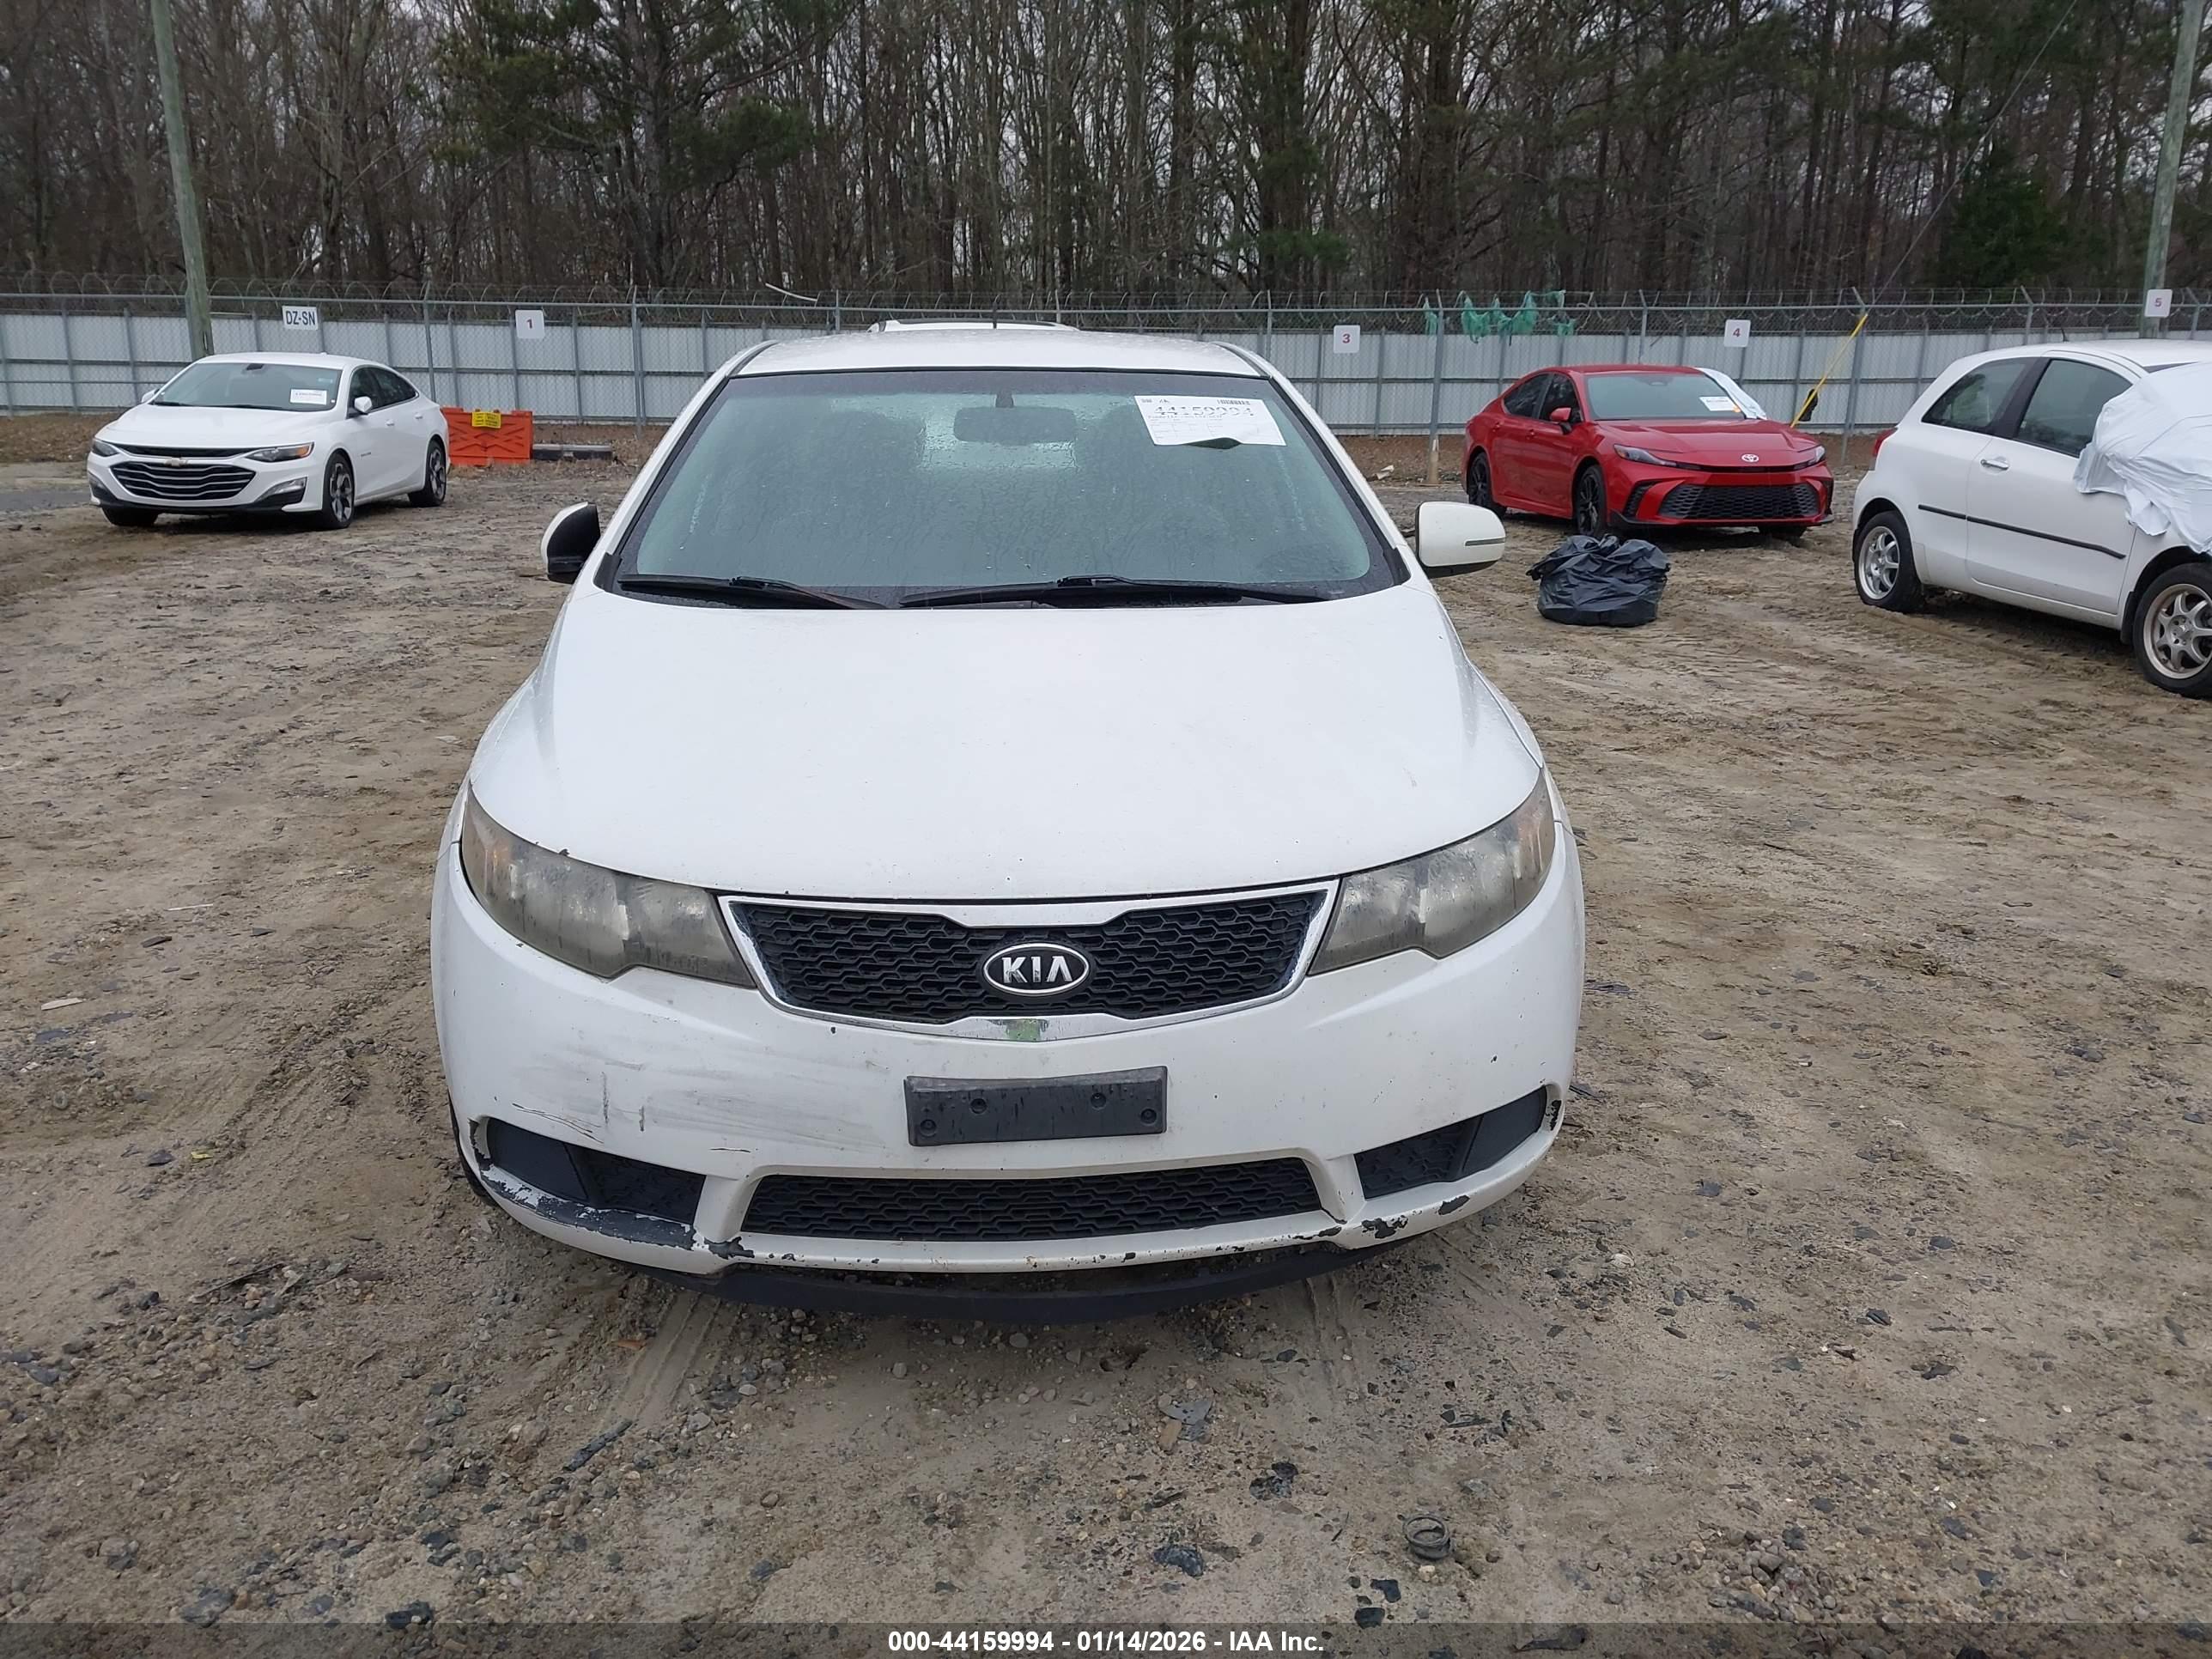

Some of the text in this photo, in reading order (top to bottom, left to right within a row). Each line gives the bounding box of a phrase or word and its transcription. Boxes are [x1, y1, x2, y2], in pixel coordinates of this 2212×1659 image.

[2154, 297, 2162, 307] 5
[285, 310, 316, 325] DZ-SN
[526, 318, 533, 329] 1
[1732, 327, 1741, 337] 4
[1342, 333, 1351, 343] 3
[1001, 956, 1073, 983] KIA
